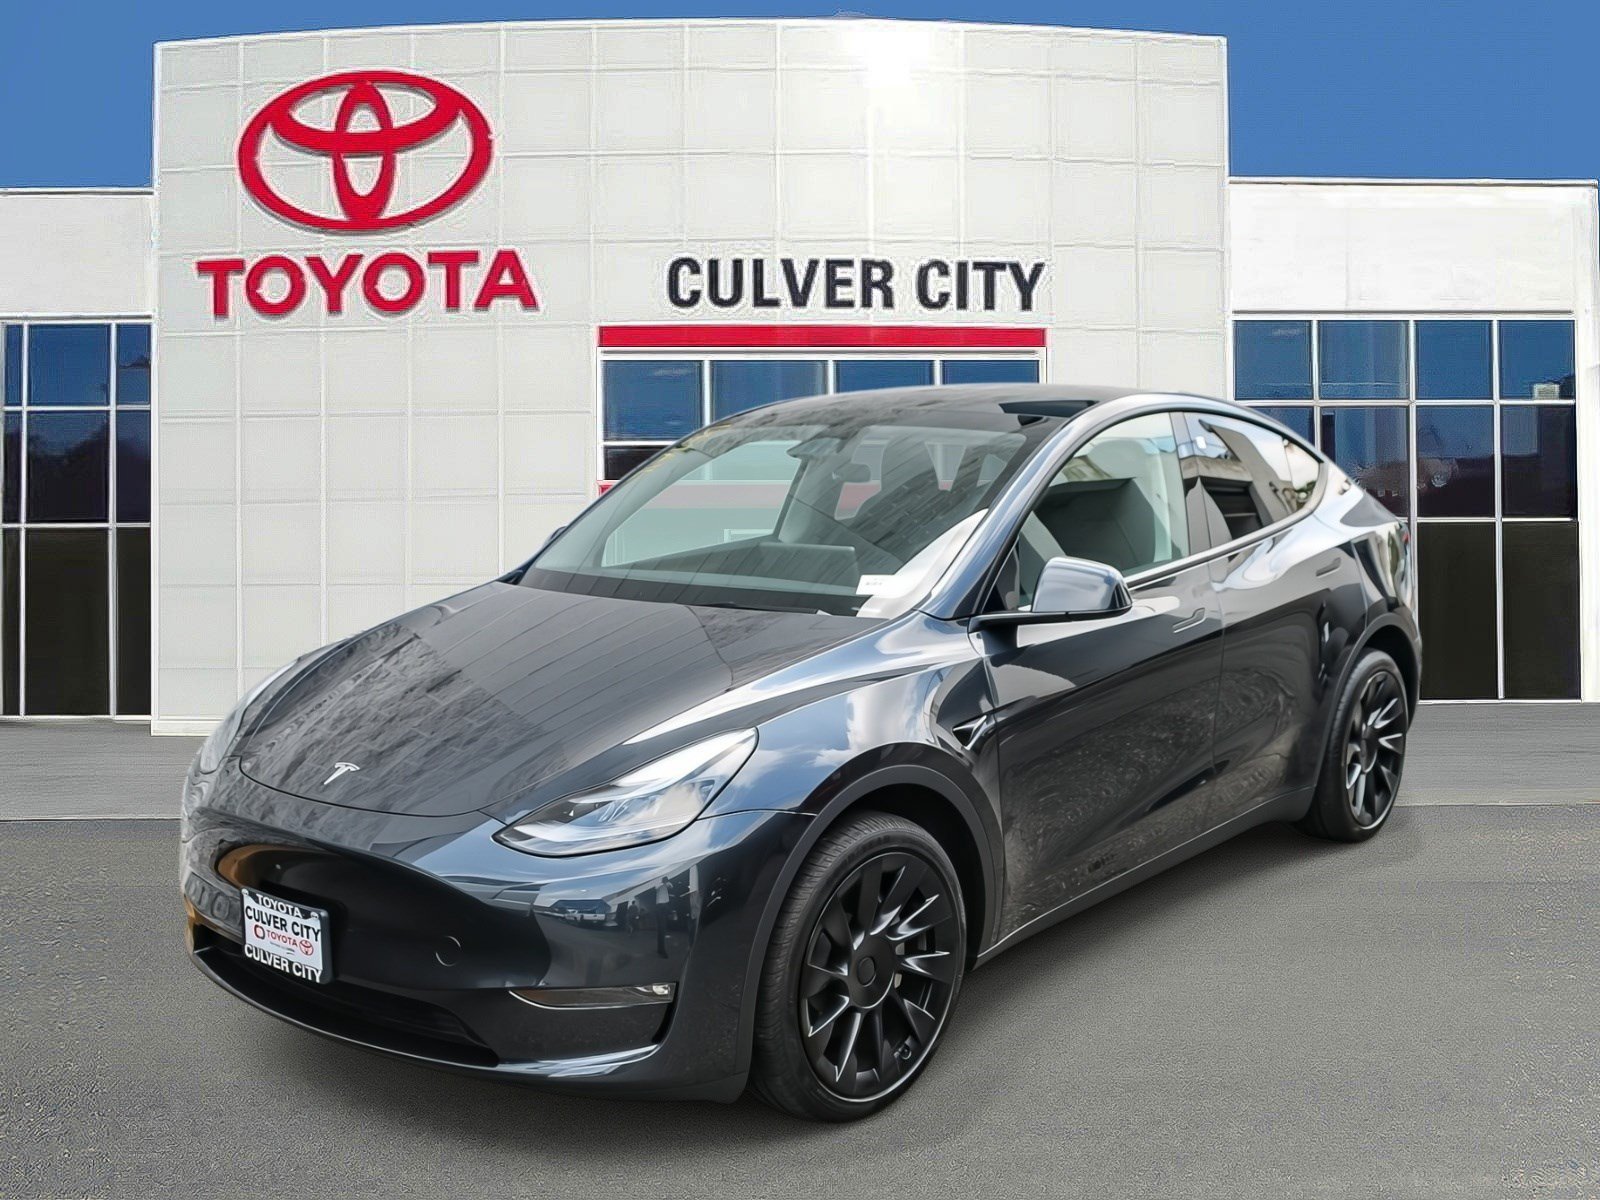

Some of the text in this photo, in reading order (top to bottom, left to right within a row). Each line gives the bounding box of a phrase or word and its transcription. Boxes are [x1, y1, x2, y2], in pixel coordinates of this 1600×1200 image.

[196, 249, 538, 319] TOYOTA
[667, 256, 1046, 312] CULVER CITY
[245, 905, 321, 942] CULVER CITY
[256, 893, 303, 919] TOYOTA
[266, 929, 298, 948] TOYOTA
[244, 943, 290, 973] CULVER
[292, 962, 322, 984] CITY
